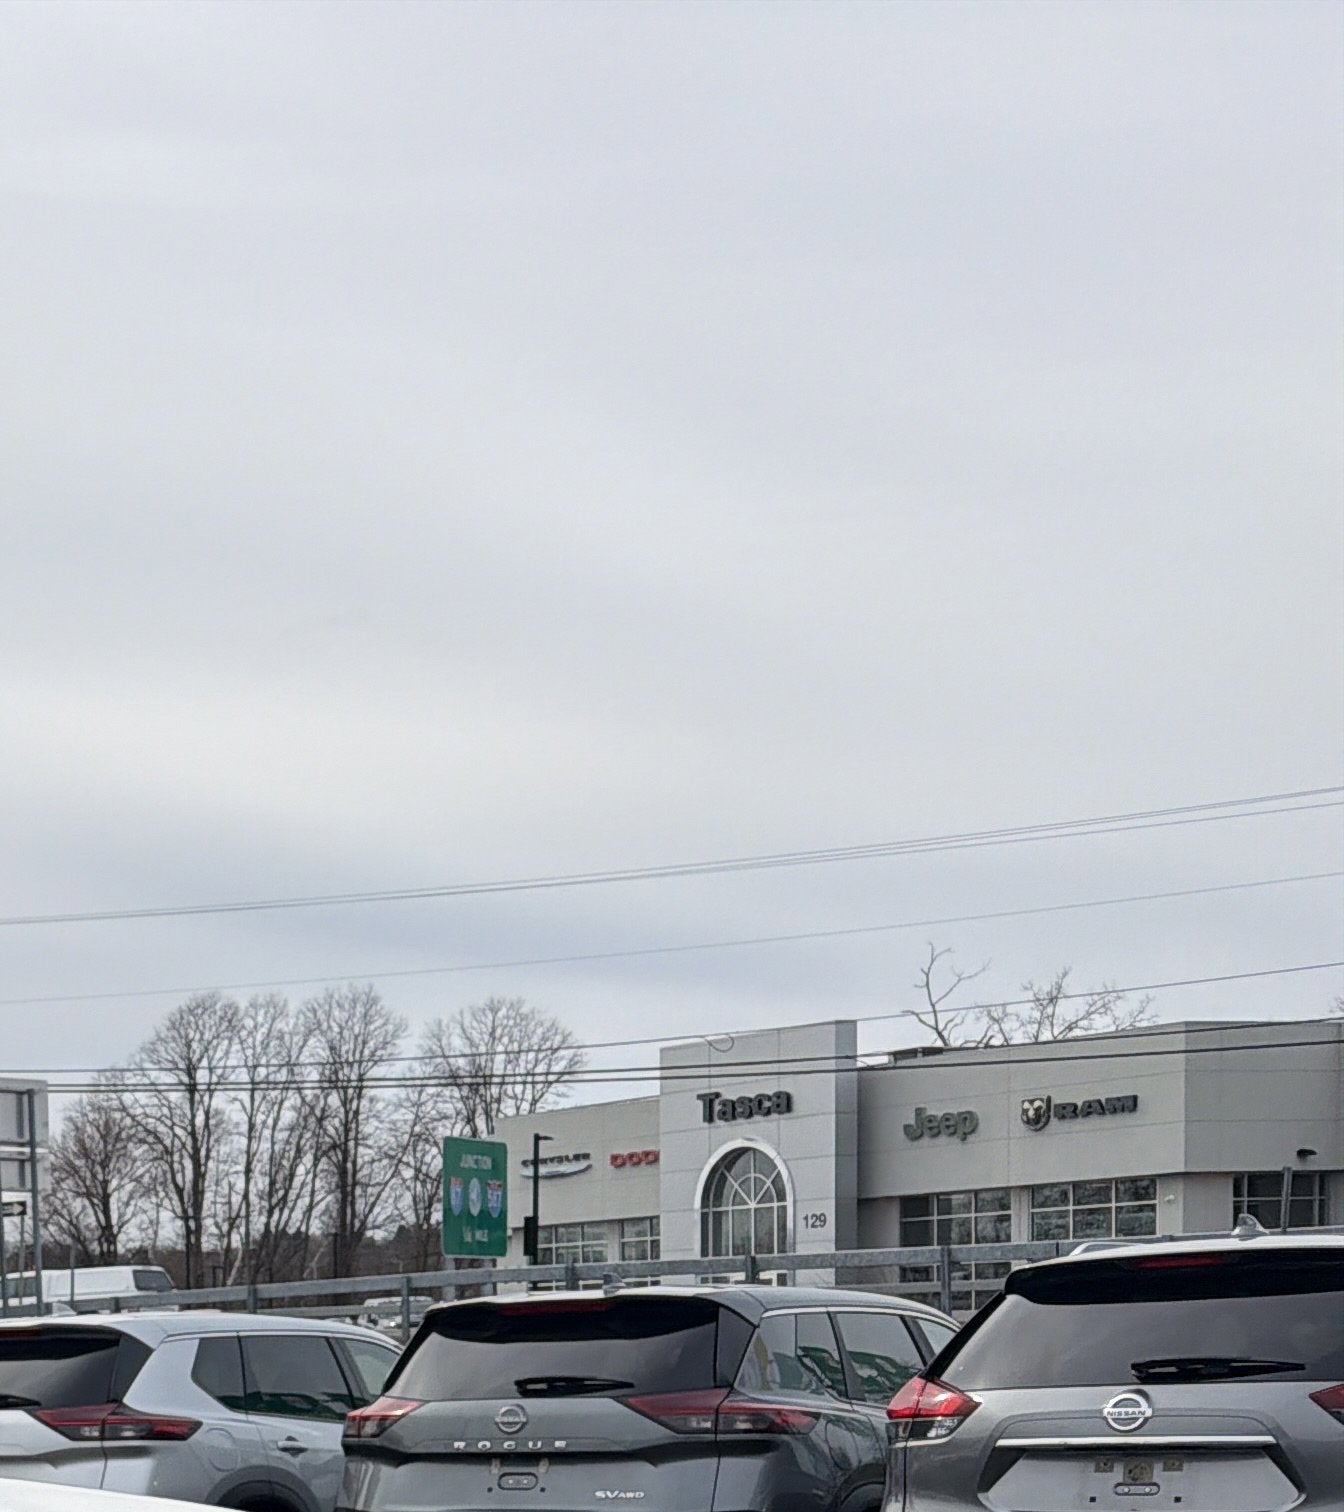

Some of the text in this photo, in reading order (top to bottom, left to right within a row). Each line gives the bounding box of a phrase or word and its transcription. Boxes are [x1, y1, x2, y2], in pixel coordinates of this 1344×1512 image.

[696, 1090, 793, 1124] Tasca
[1053, 1094, 1139, 1121] RAM
[903, 1107, 979, 1142] Jeep
[802, 1212, 827, 1229] 129
[453, 1440, 567, 1450] ROGUE
